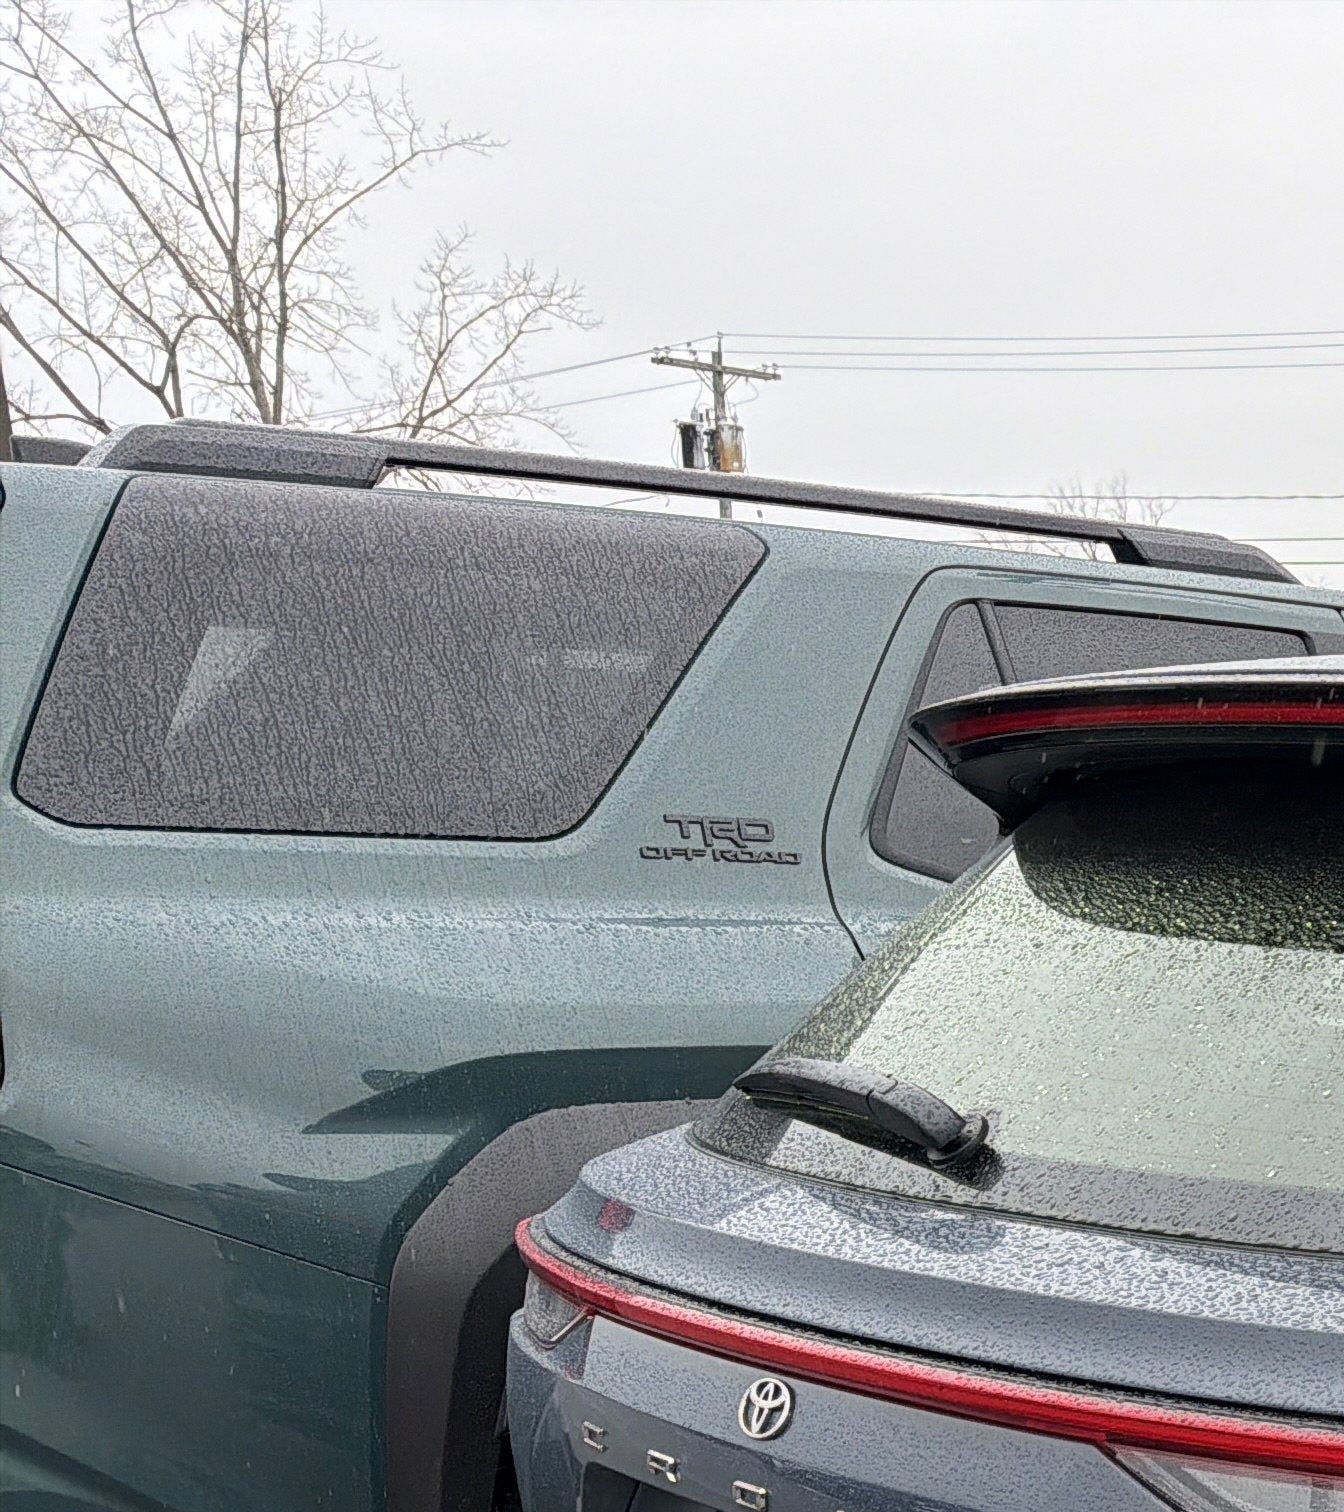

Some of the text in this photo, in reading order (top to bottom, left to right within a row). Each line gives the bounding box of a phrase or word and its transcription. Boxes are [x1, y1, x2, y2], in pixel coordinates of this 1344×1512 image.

[663, 813, 775, 849] TRD
[640, 845, 801, 865] OFF ROAD
